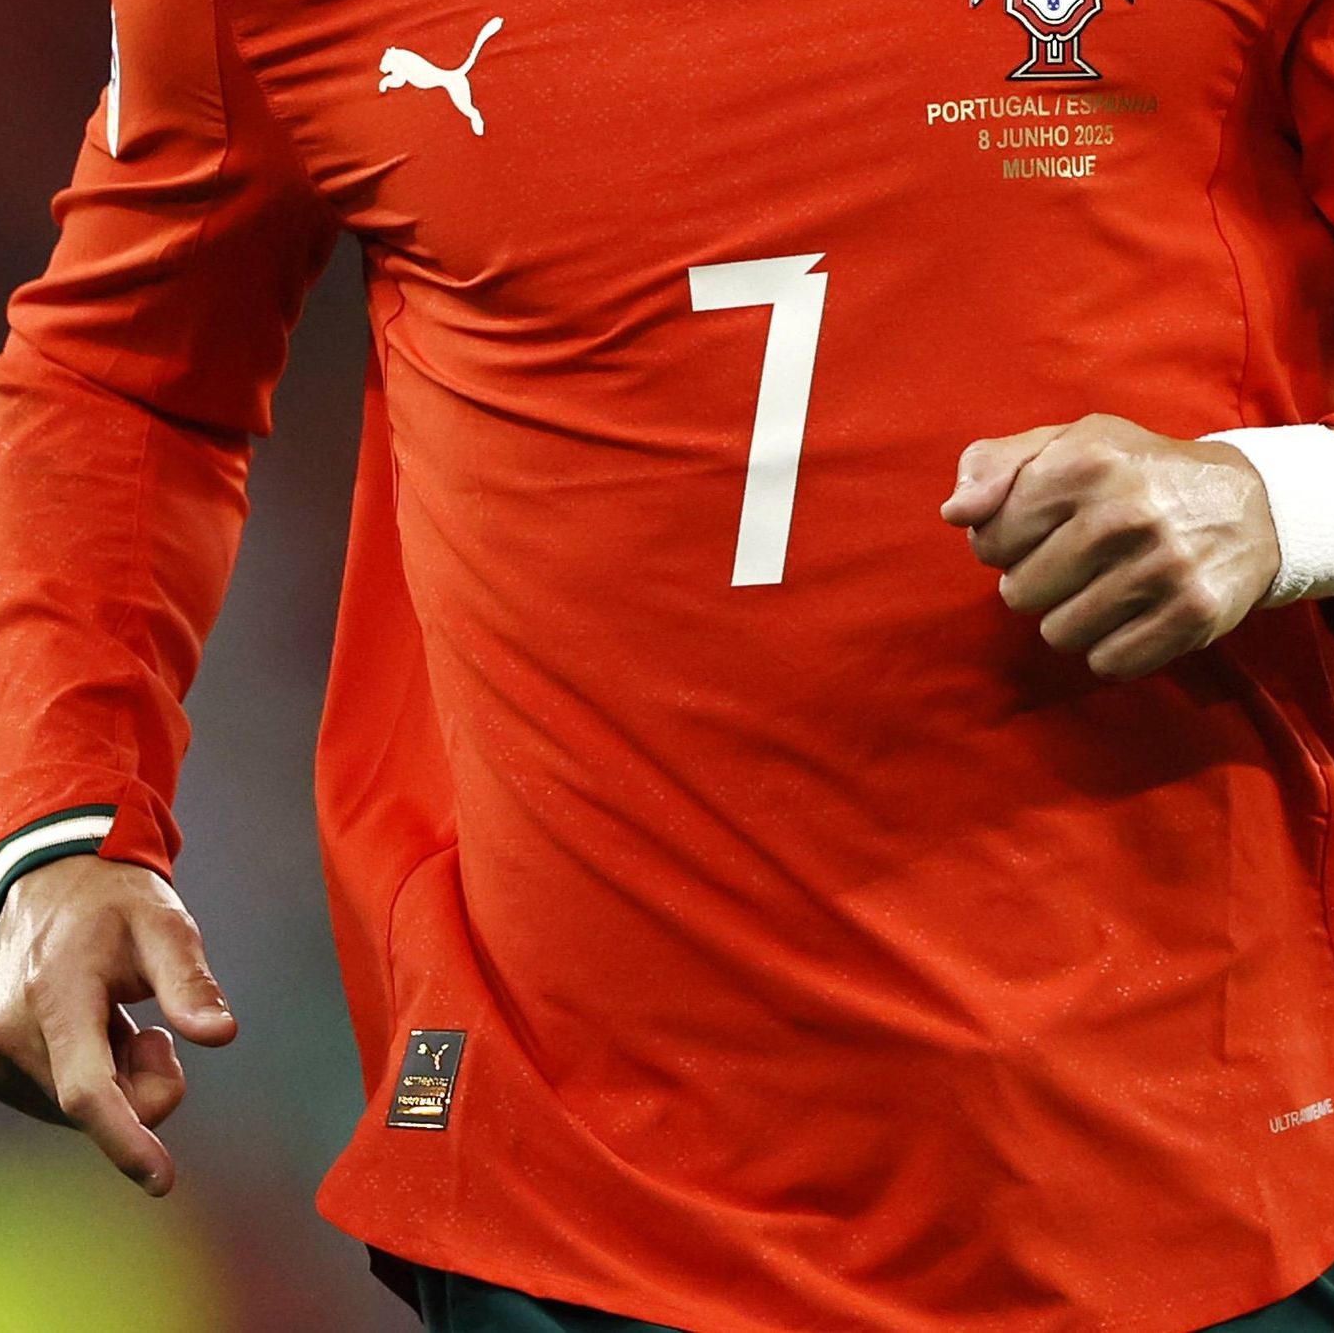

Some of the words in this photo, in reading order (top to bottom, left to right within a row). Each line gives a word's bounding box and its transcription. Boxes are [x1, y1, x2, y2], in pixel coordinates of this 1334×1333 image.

[927, 95, 1050, 125] PORTUGAL
[1055, 95, 1061, 116] /
[978, 129, 990, 150] 8
[996, 125, 1069, 149] JUNHO
[1074, 125, 1114, 146] 2025
[1003, 155, 1097, 179] MUNIQUE
[688, 252, 829, 587] 7
